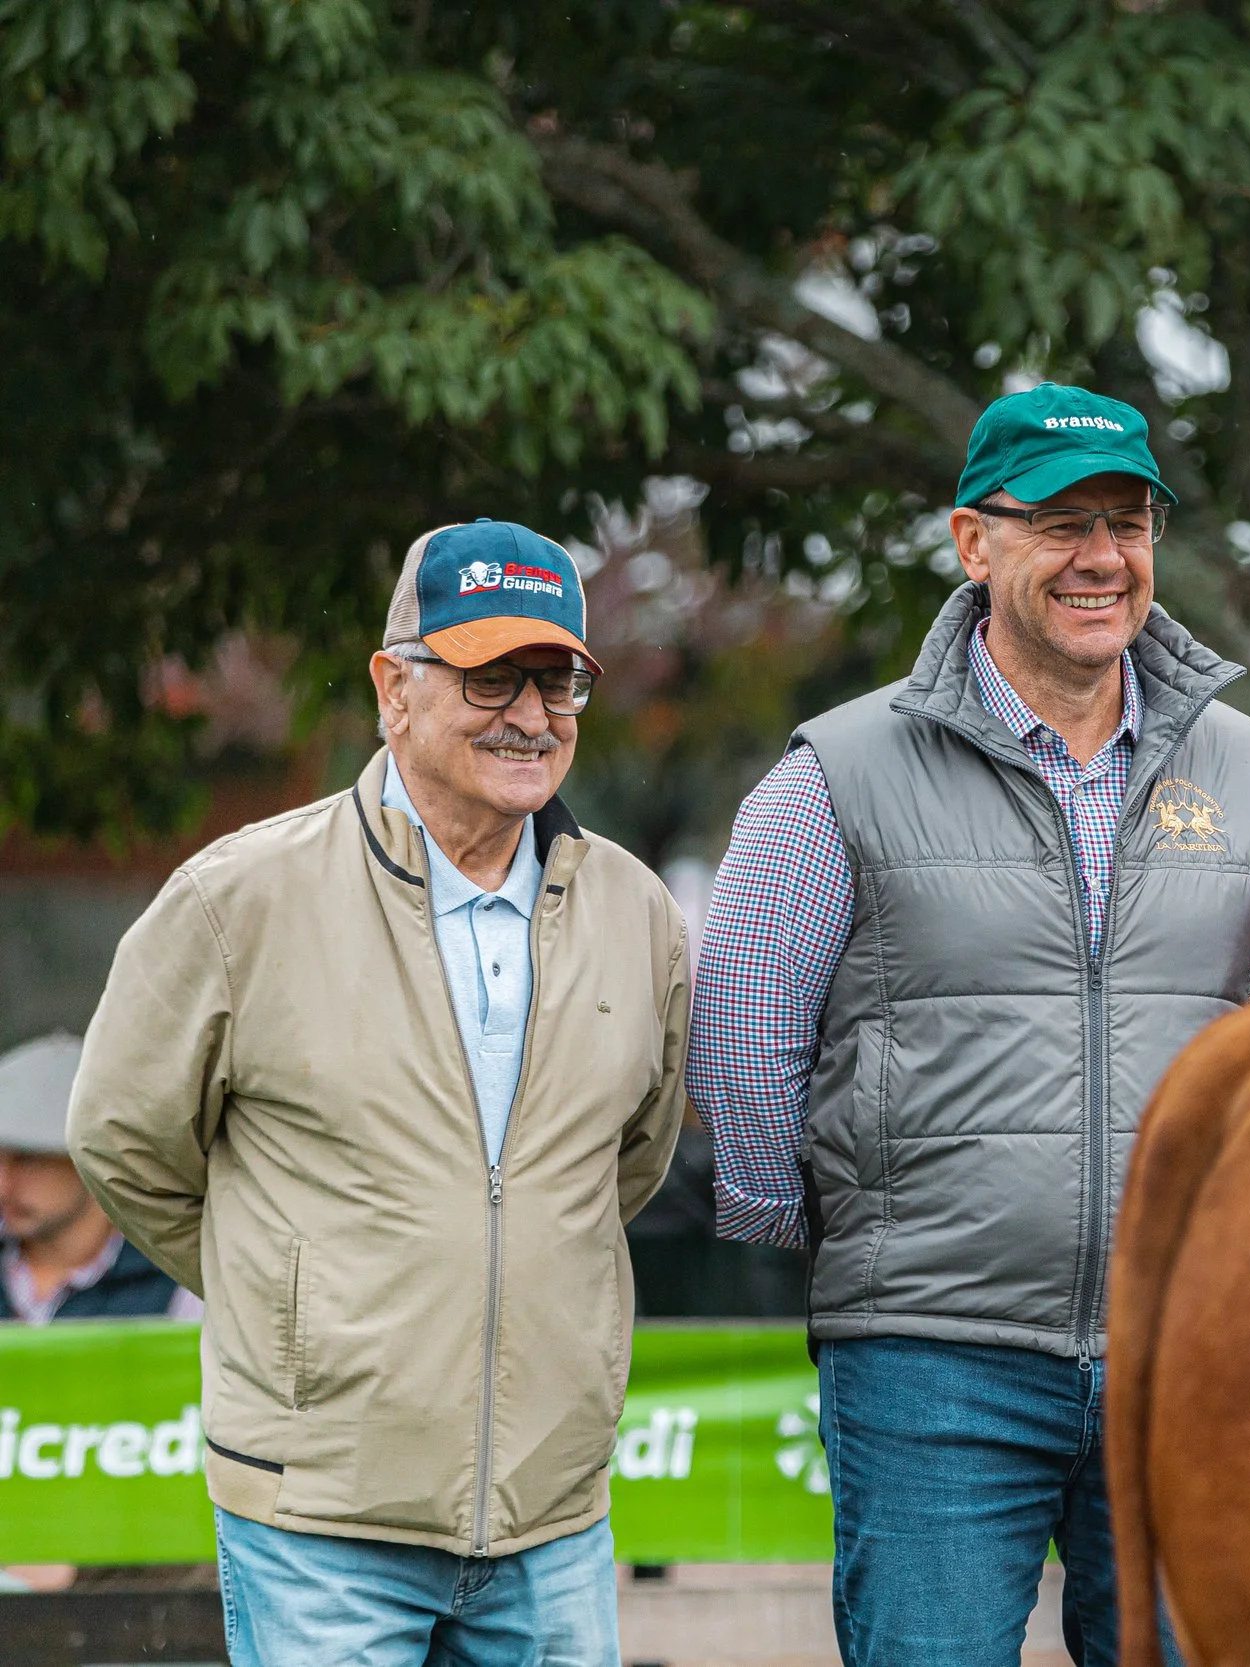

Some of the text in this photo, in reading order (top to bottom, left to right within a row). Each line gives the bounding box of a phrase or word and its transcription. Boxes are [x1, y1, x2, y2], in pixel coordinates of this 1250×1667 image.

[1043, 415, 1124, 432] Brangus
[504, 562, 563, 585] Brangus
[503, 577, 563, 598] Guapiara
[1174, 777, 1193, 789] POLO
[1155, 841, 1227, 852] LA MARTINA
[0, 1404, 205, 1479] icred
[610, 1406, 698, 1480] di
